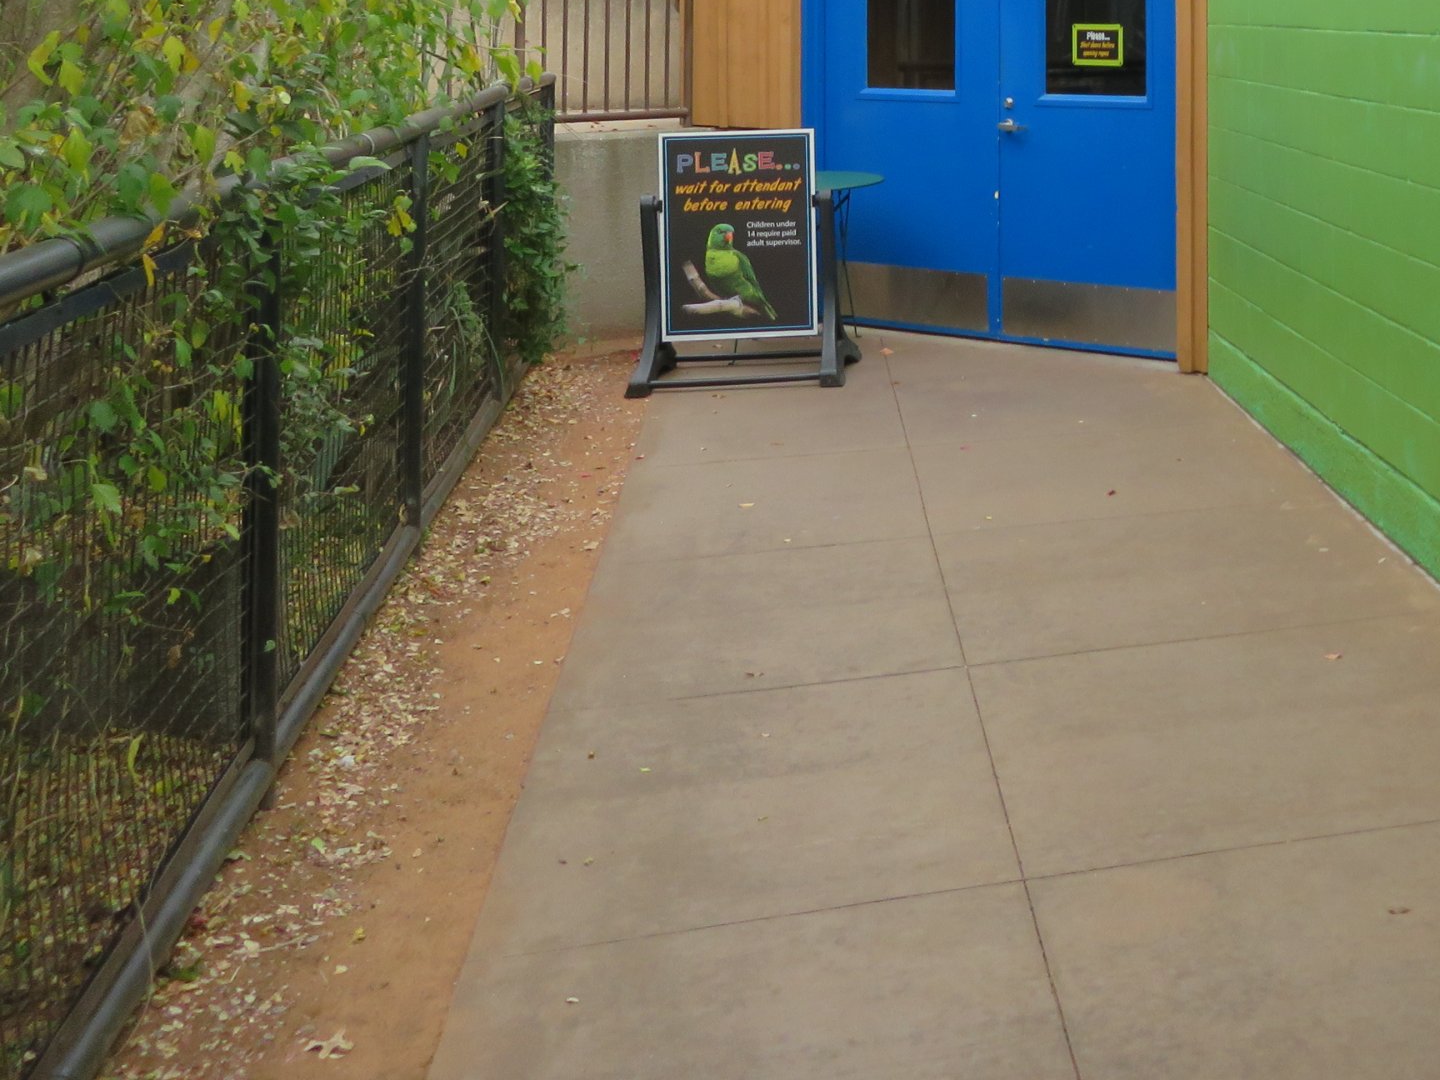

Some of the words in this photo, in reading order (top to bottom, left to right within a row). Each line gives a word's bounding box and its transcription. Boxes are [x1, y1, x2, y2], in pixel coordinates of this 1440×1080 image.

[675, 180, 707, 195] wait
[709, 180, 731, 194] for
[733, 177, 802, 193] attendant
[683, 197, 728, 212] before
[735, 196, 792, 212] entering
[746, 220, 775, 228] Children
[776, 220, 796, 228] under
[756, 230, 781, 238] require
[781, 229, 797, 238] paid
[746, 239, 765, 247] adult
[765, 239, 802, 247] supervisor.
